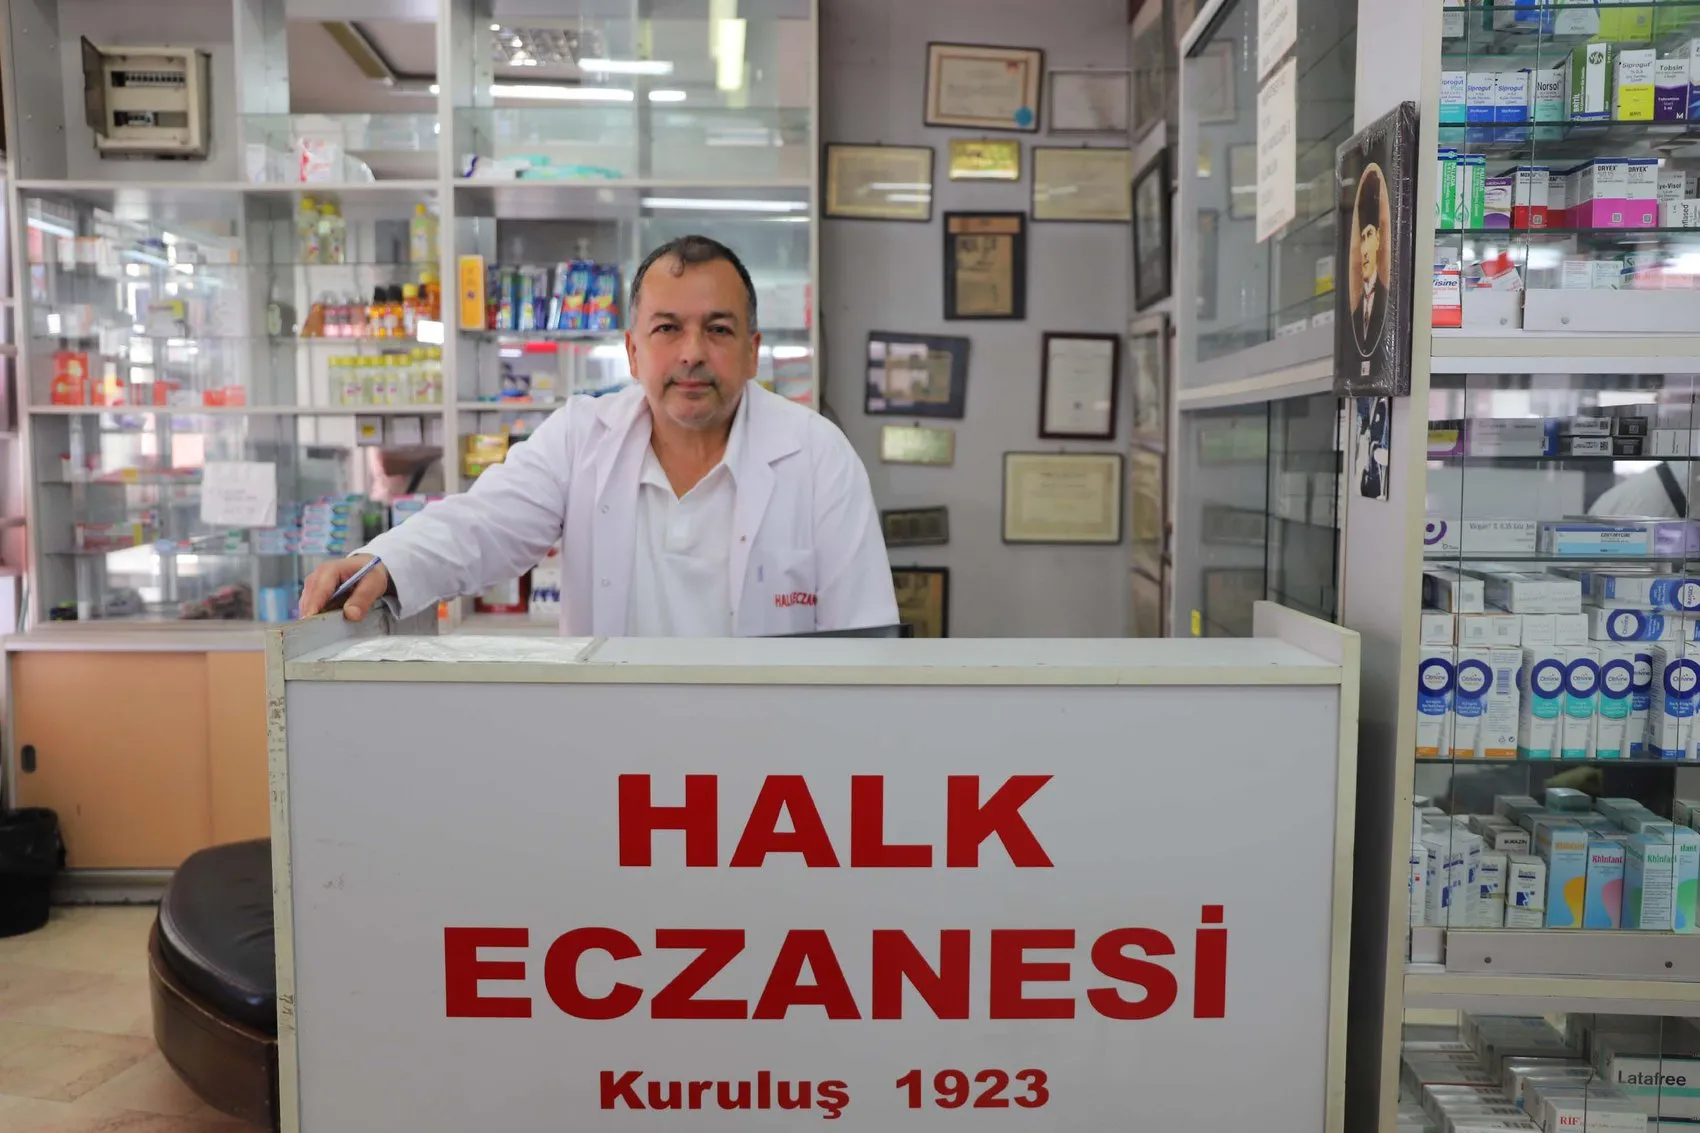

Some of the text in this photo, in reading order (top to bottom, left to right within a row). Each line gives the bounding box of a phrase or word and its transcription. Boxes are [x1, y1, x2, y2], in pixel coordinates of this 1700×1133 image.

[1537, 82, 1560, 91] Norsol
[618, 773, 1054, 868] HALK
[445, 904, 1228, 1021] ECZANESİ
[599, 1069, 1050, 1119] Kuruluş 1923
[1618, 1070, 1687, 1086] Latafree
